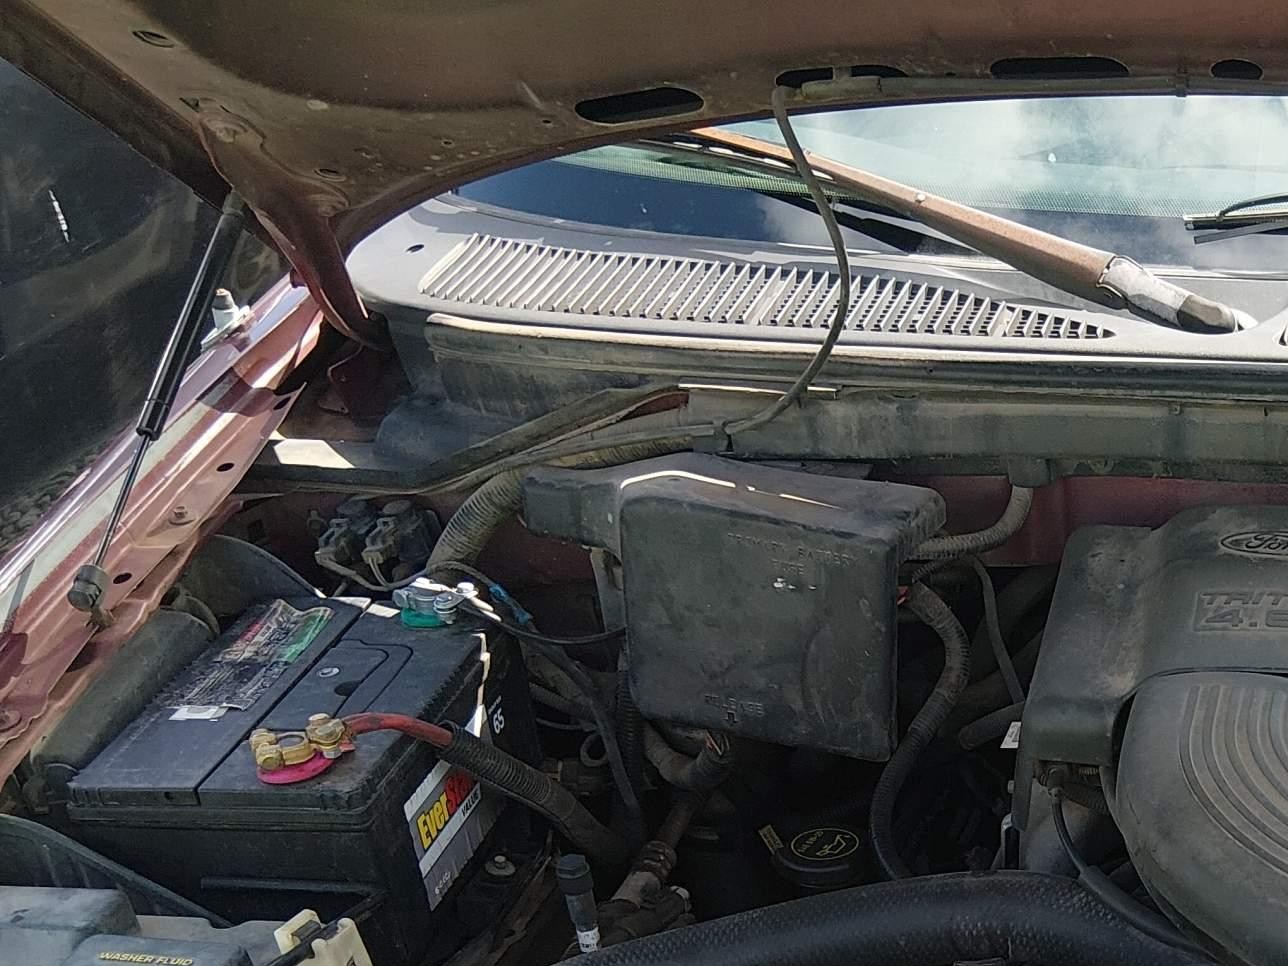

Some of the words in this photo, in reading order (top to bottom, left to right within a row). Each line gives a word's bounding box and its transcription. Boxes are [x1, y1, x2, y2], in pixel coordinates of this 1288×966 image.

[492, 707, 505, 735] 65
[97, 951, 154, 964] WASHER
[155, 955, 194, 966] FLUID
